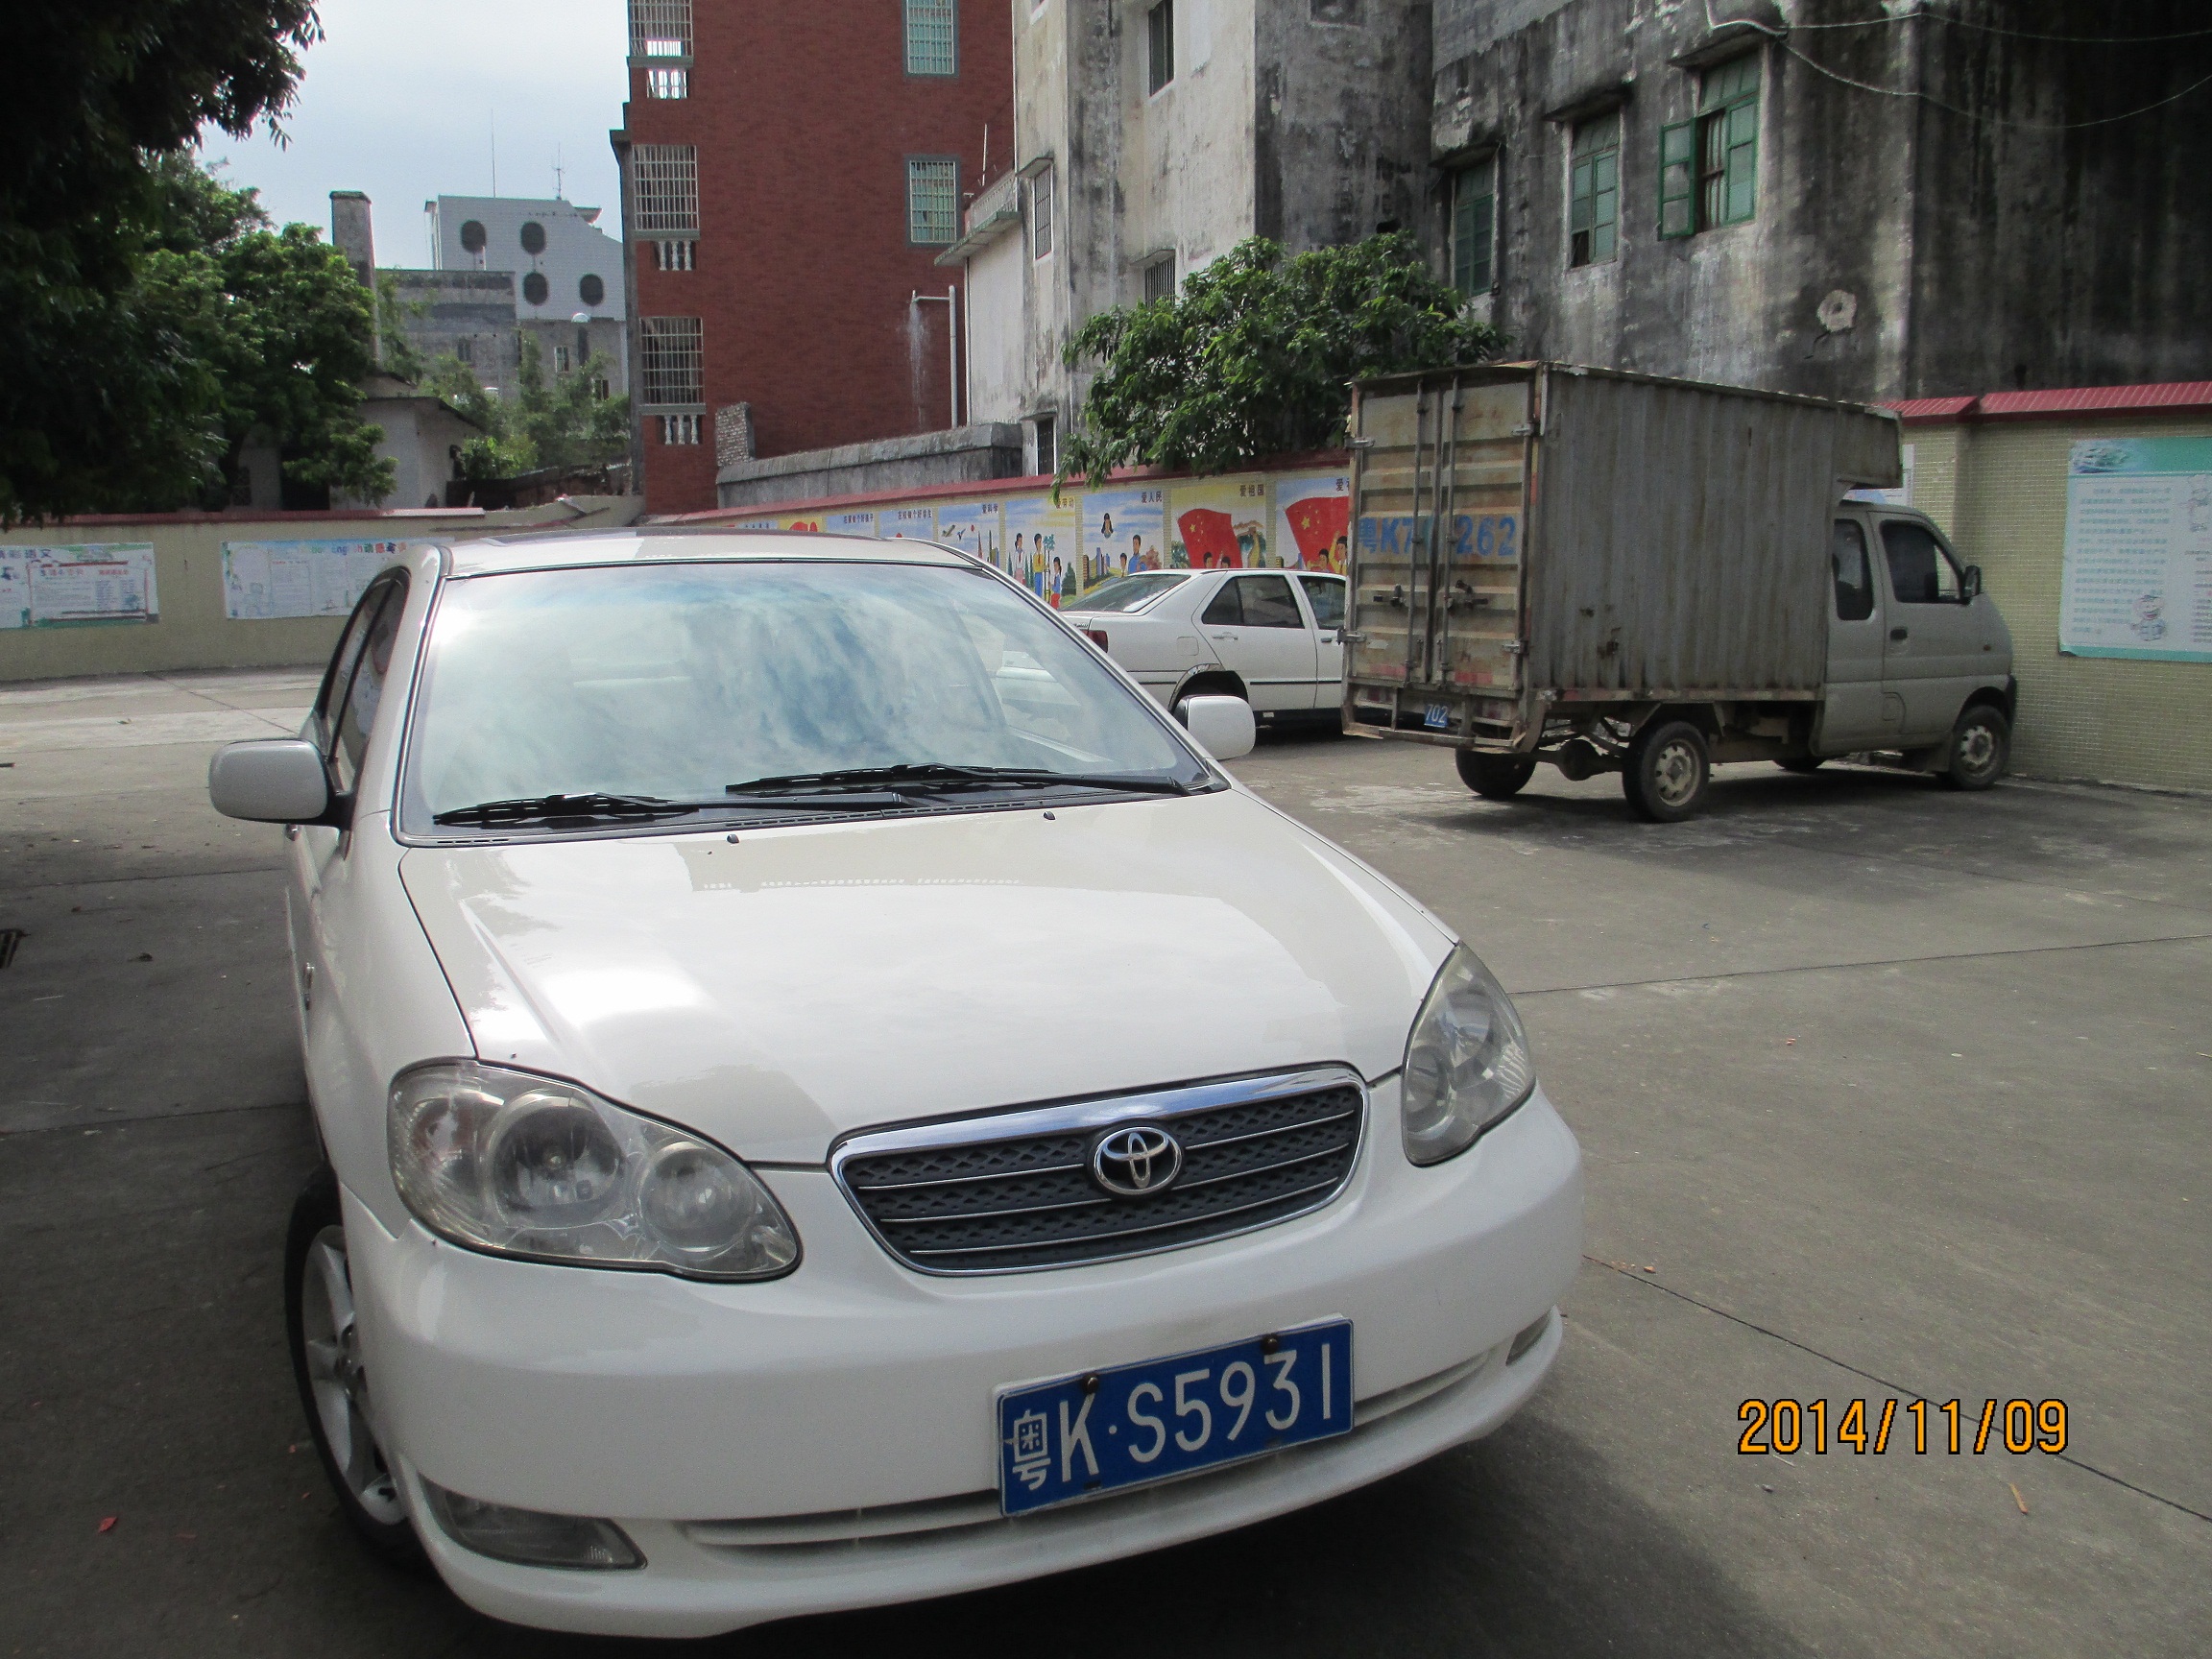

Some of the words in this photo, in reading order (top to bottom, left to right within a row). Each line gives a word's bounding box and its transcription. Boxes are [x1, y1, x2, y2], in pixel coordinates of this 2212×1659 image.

[1239, 484, 1264, 497] 爱祖国
[1141, 491, 1163, 504] 爱人民
